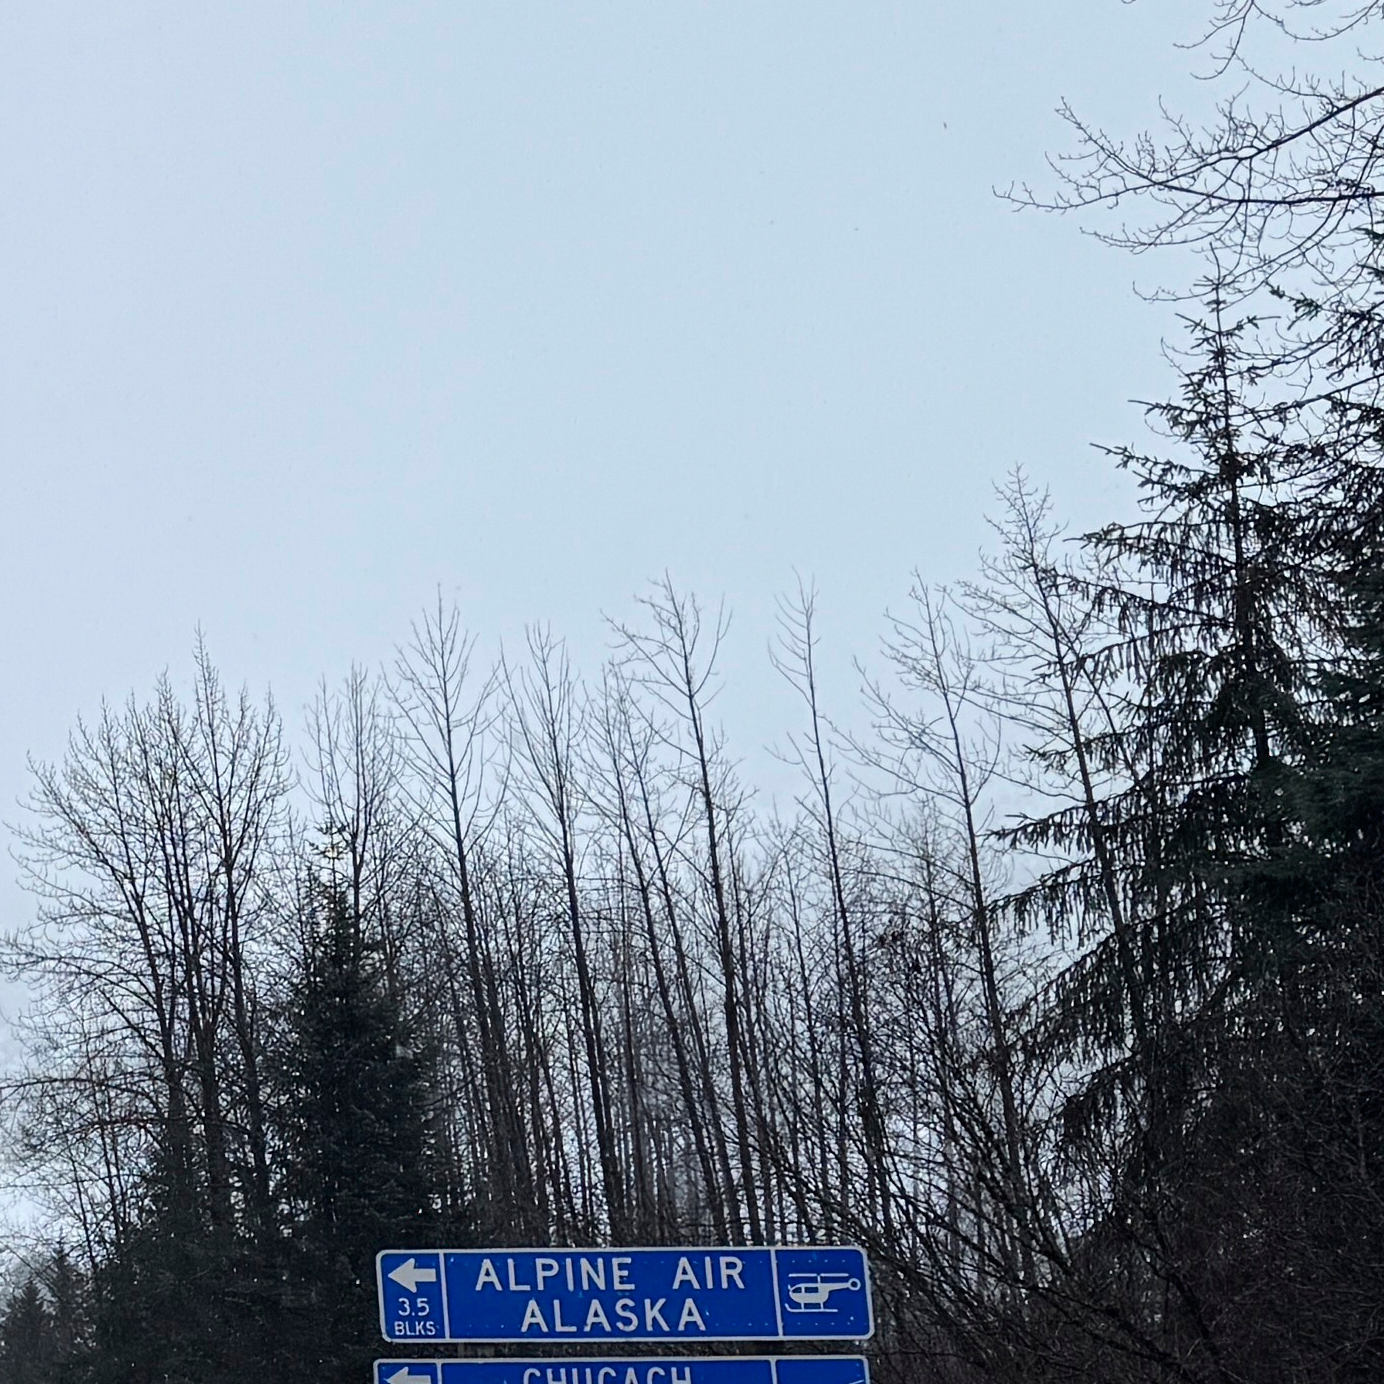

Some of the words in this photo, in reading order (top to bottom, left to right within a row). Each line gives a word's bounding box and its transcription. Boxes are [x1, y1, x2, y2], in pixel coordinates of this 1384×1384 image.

[475, 1257, 635, 1291] ALPINE
[672, 1256, 745, 1289] AIR
[398, 1298, 429, 1316] 3.5
[520, 1298, 706, 1332] ALASKA
[394, 1321, 436, 1335] BLKS
